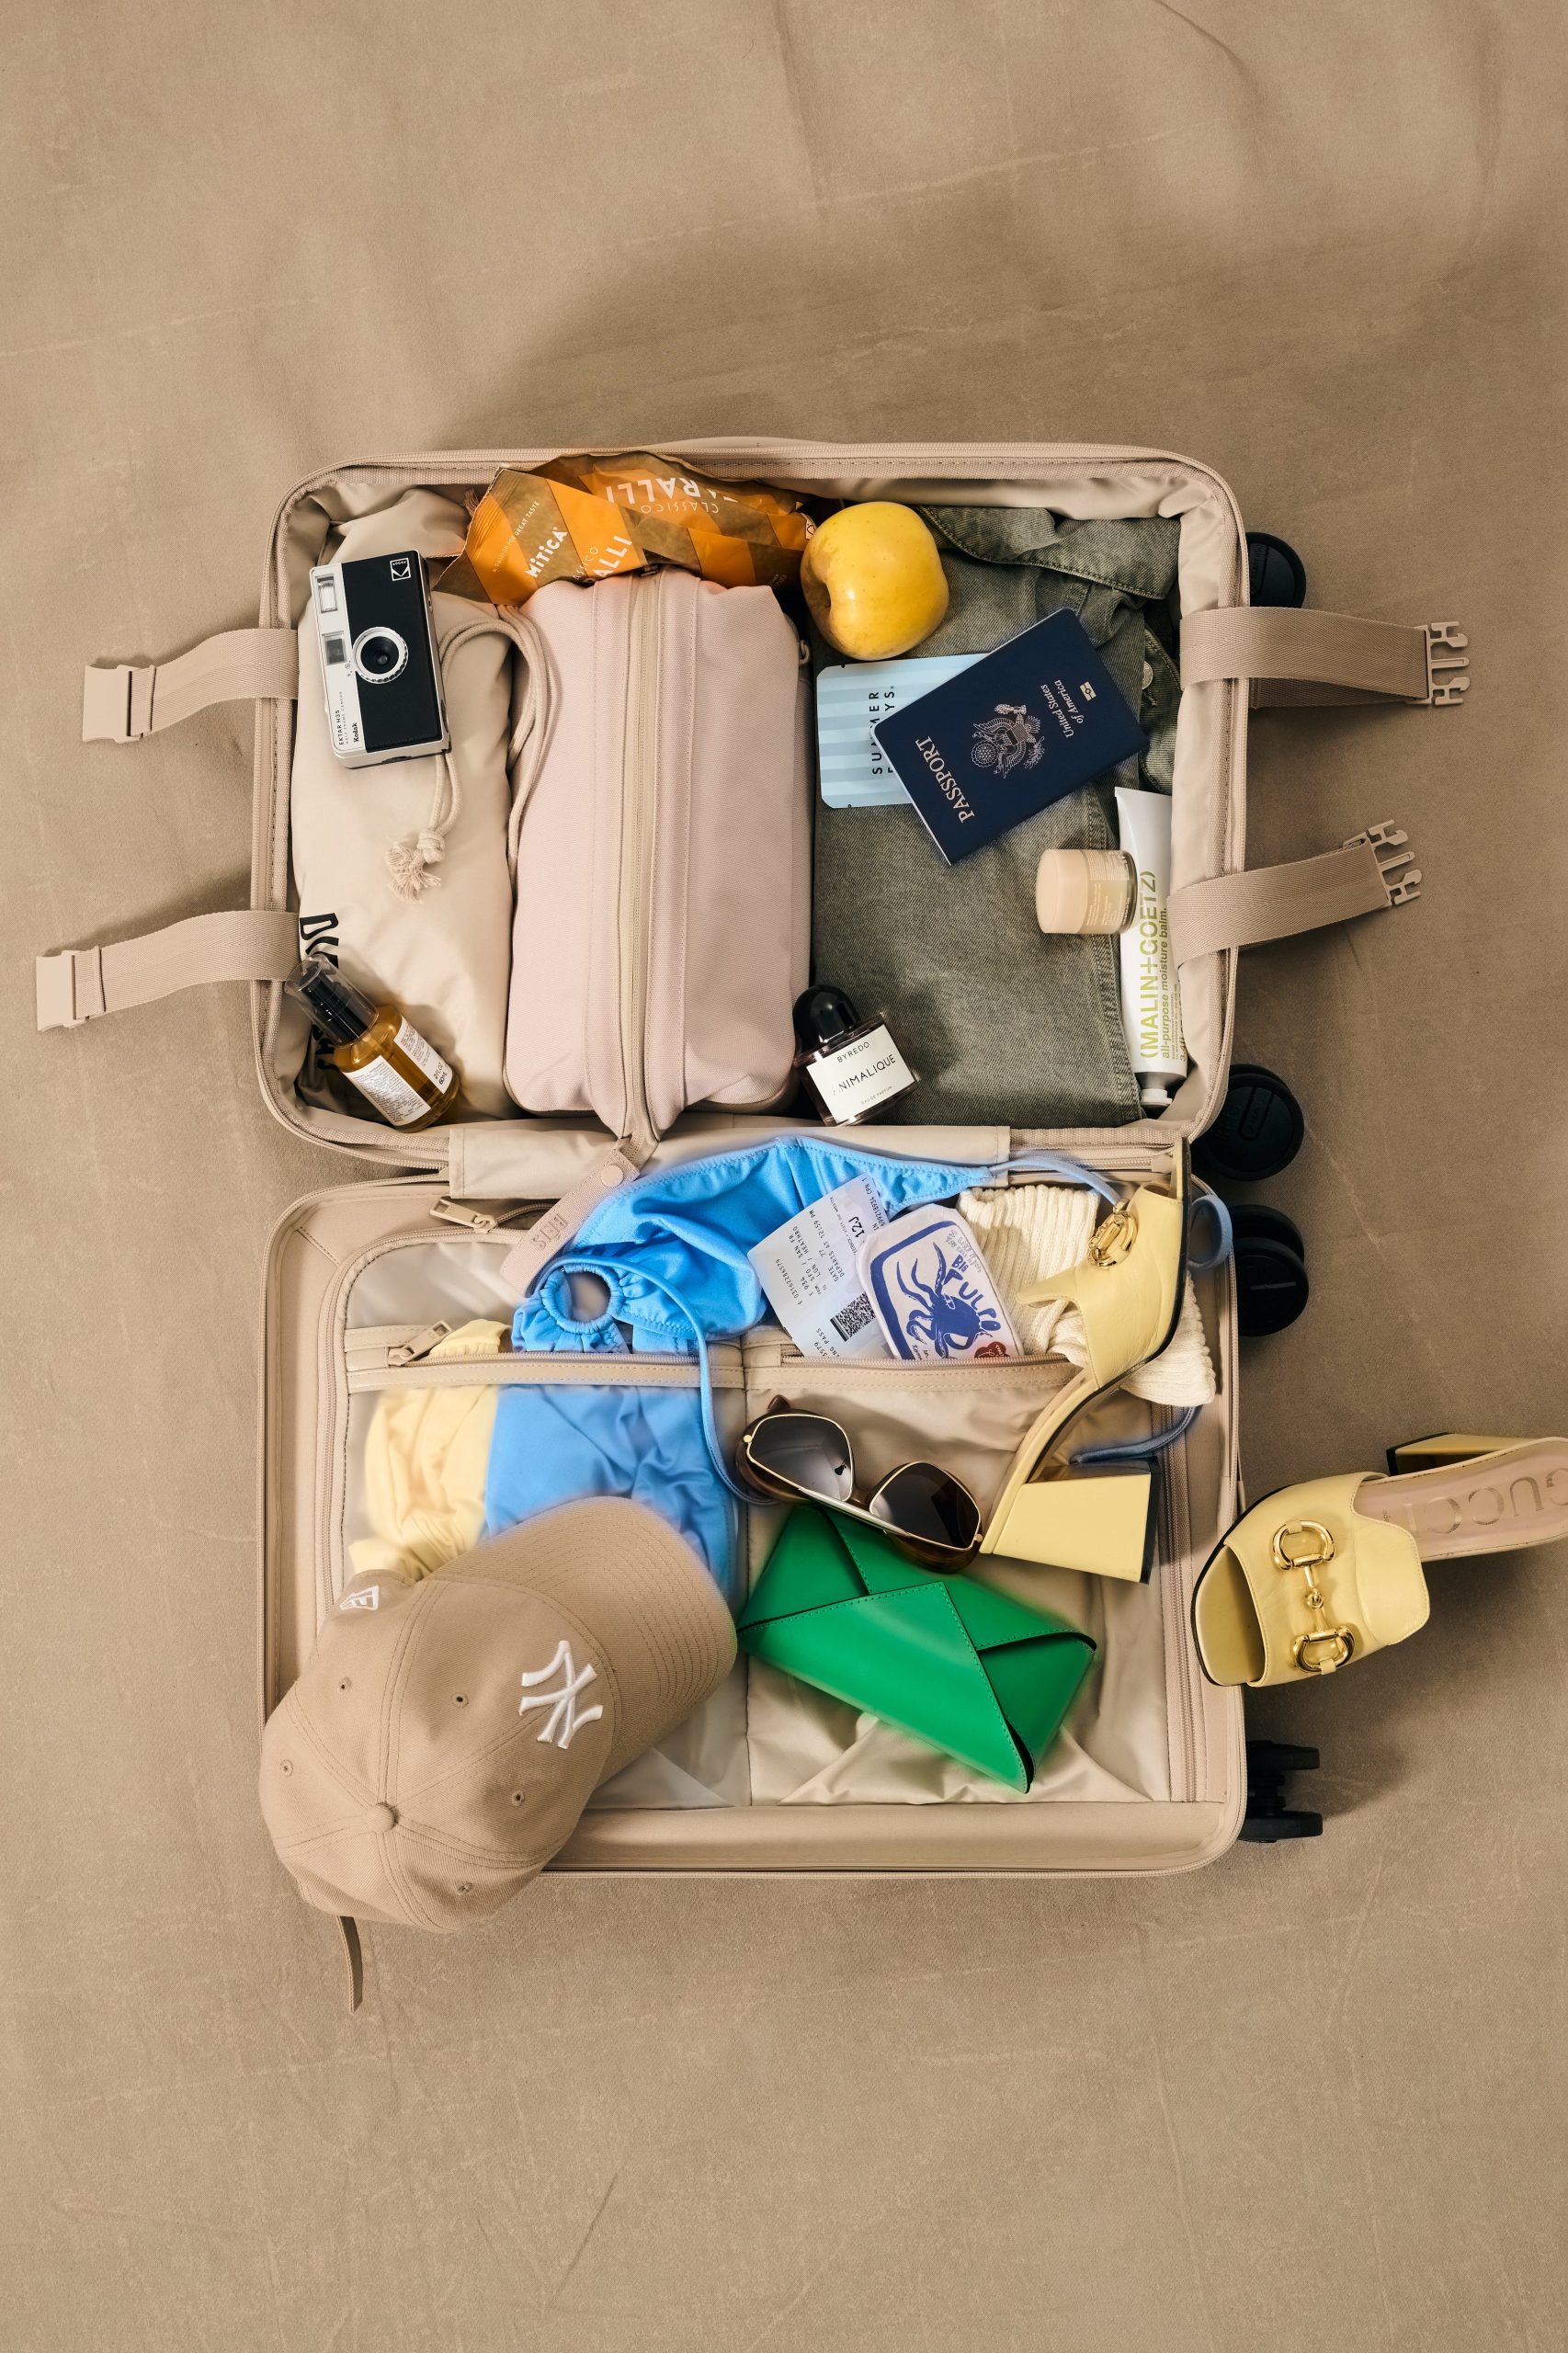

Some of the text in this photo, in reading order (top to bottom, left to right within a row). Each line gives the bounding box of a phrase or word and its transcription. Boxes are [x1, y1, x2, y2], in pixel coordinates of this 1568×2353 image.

[606, 477, 738, 502] RALLI
[513, 517, 528, 537] GREAT
[525, 499, 540, 518] TASTE
[640, 502, 718, 513] CLASSICO
[572, 546, 599, 580] ASSICO
[592, 535, 632, 577] ALLI
[1040, 683, 1073, 737] United States
[1053, 678, 1084, 724] of America
[869, 691, 881, 774] SUER
[915, 735, 975, 824] PASSPORT
[1139, 870, 1158, 1057] (MALIN+GOETZ)
[1158, 941, 1167, 990] moisture
[1161, 995, 1171, 1057] all-purpose
[836, 1040, 869, 1063] BYREDO
[863, 1183, 873, 1195] CPN
[788, 1233, 796, 1243] FR
[791, 1225, 810, 1254] HEATHRO
[846, 1215, 866, 1238] 12J
[793, 1245, 803, 1257] SAN
[808, 1208, 845, 1277] DEPARTS AT 12:59 PM
[805, 1267, 815, 1281] SFO
[810, 1263, 821, 1277] LON
[818, 1247, 839, 1281] GATE 77
[951, 1255, 968, 1272] BIG
[799, 1276, 810, 1290] 934
[815, 1327, 829, 1344] PASS
